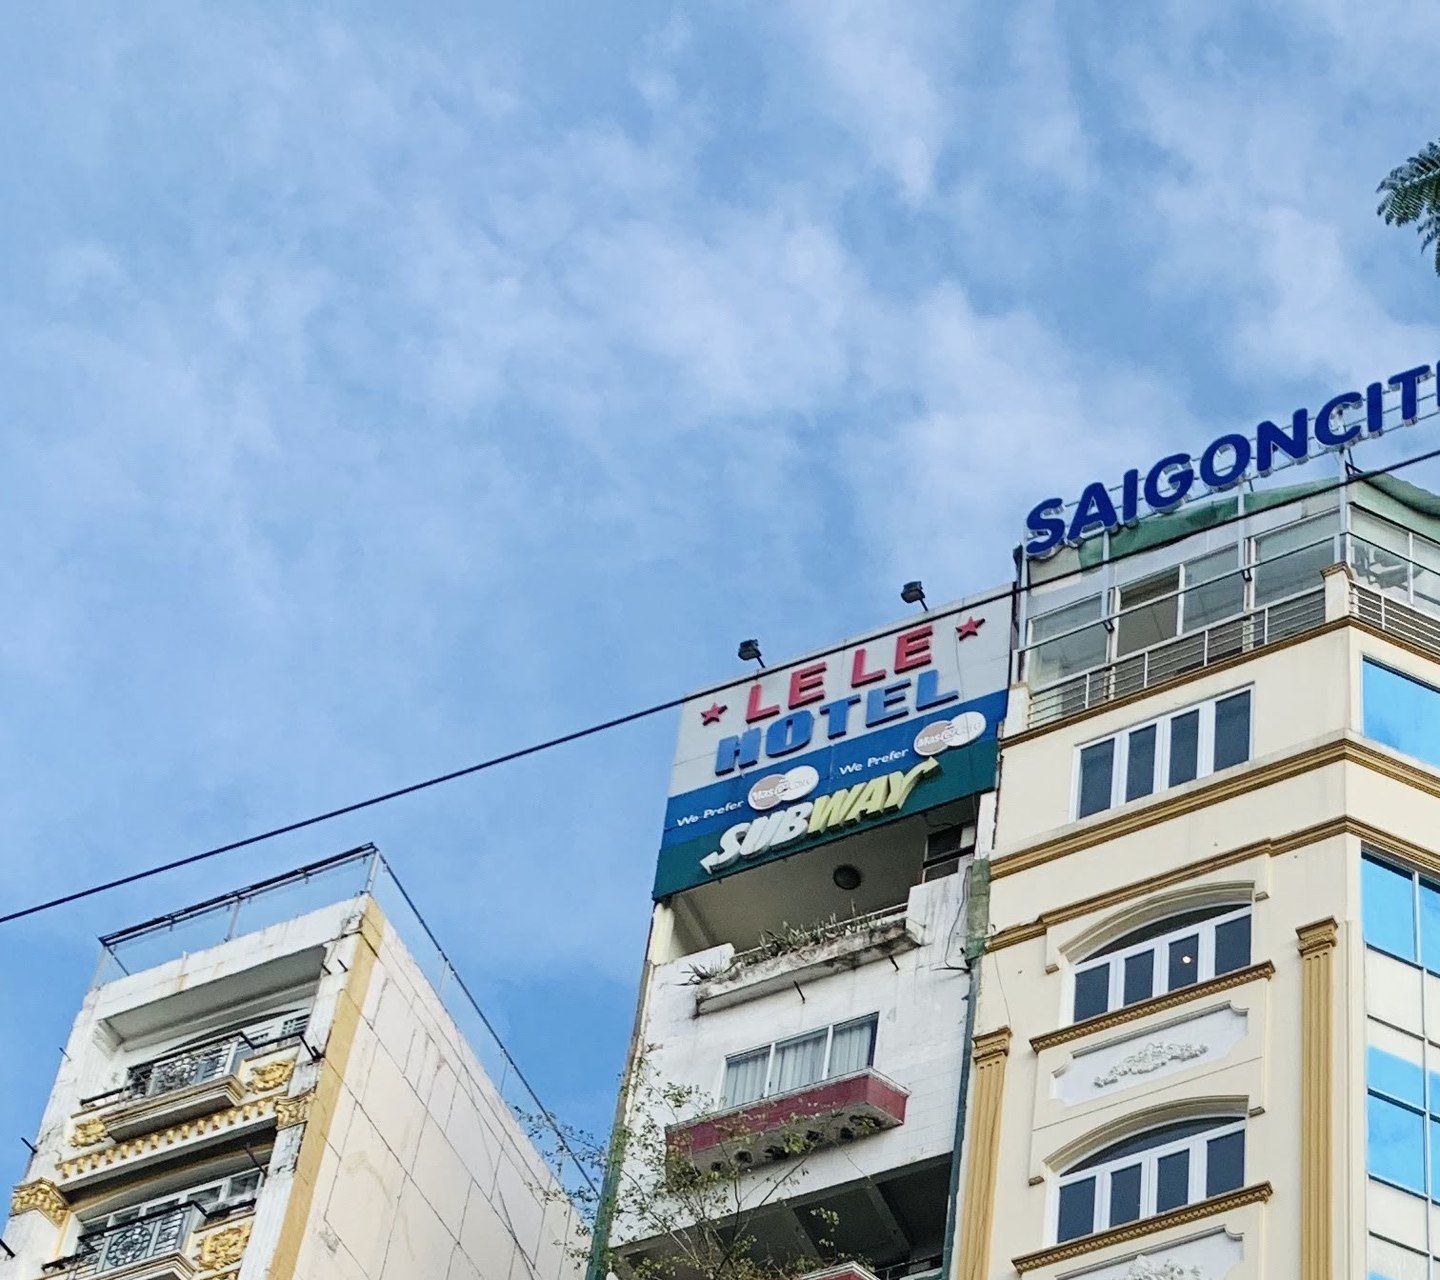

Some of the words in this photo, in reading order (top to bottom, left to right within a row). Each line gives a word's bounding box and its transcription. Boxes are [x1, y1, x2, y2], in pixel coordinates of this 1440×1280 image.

[715, 669, 960, 776] HOTEL
[746, 662, 828, 724] LE
[851, 625, 934, 688] LE
[840, 763, 863, 775] We
[867, 749, 909, 767] Prefer
[677, 815, 701, 827] We
[703, 801, 744, 820] Prefer
[700, 756, 940, 875] SUBWAY
